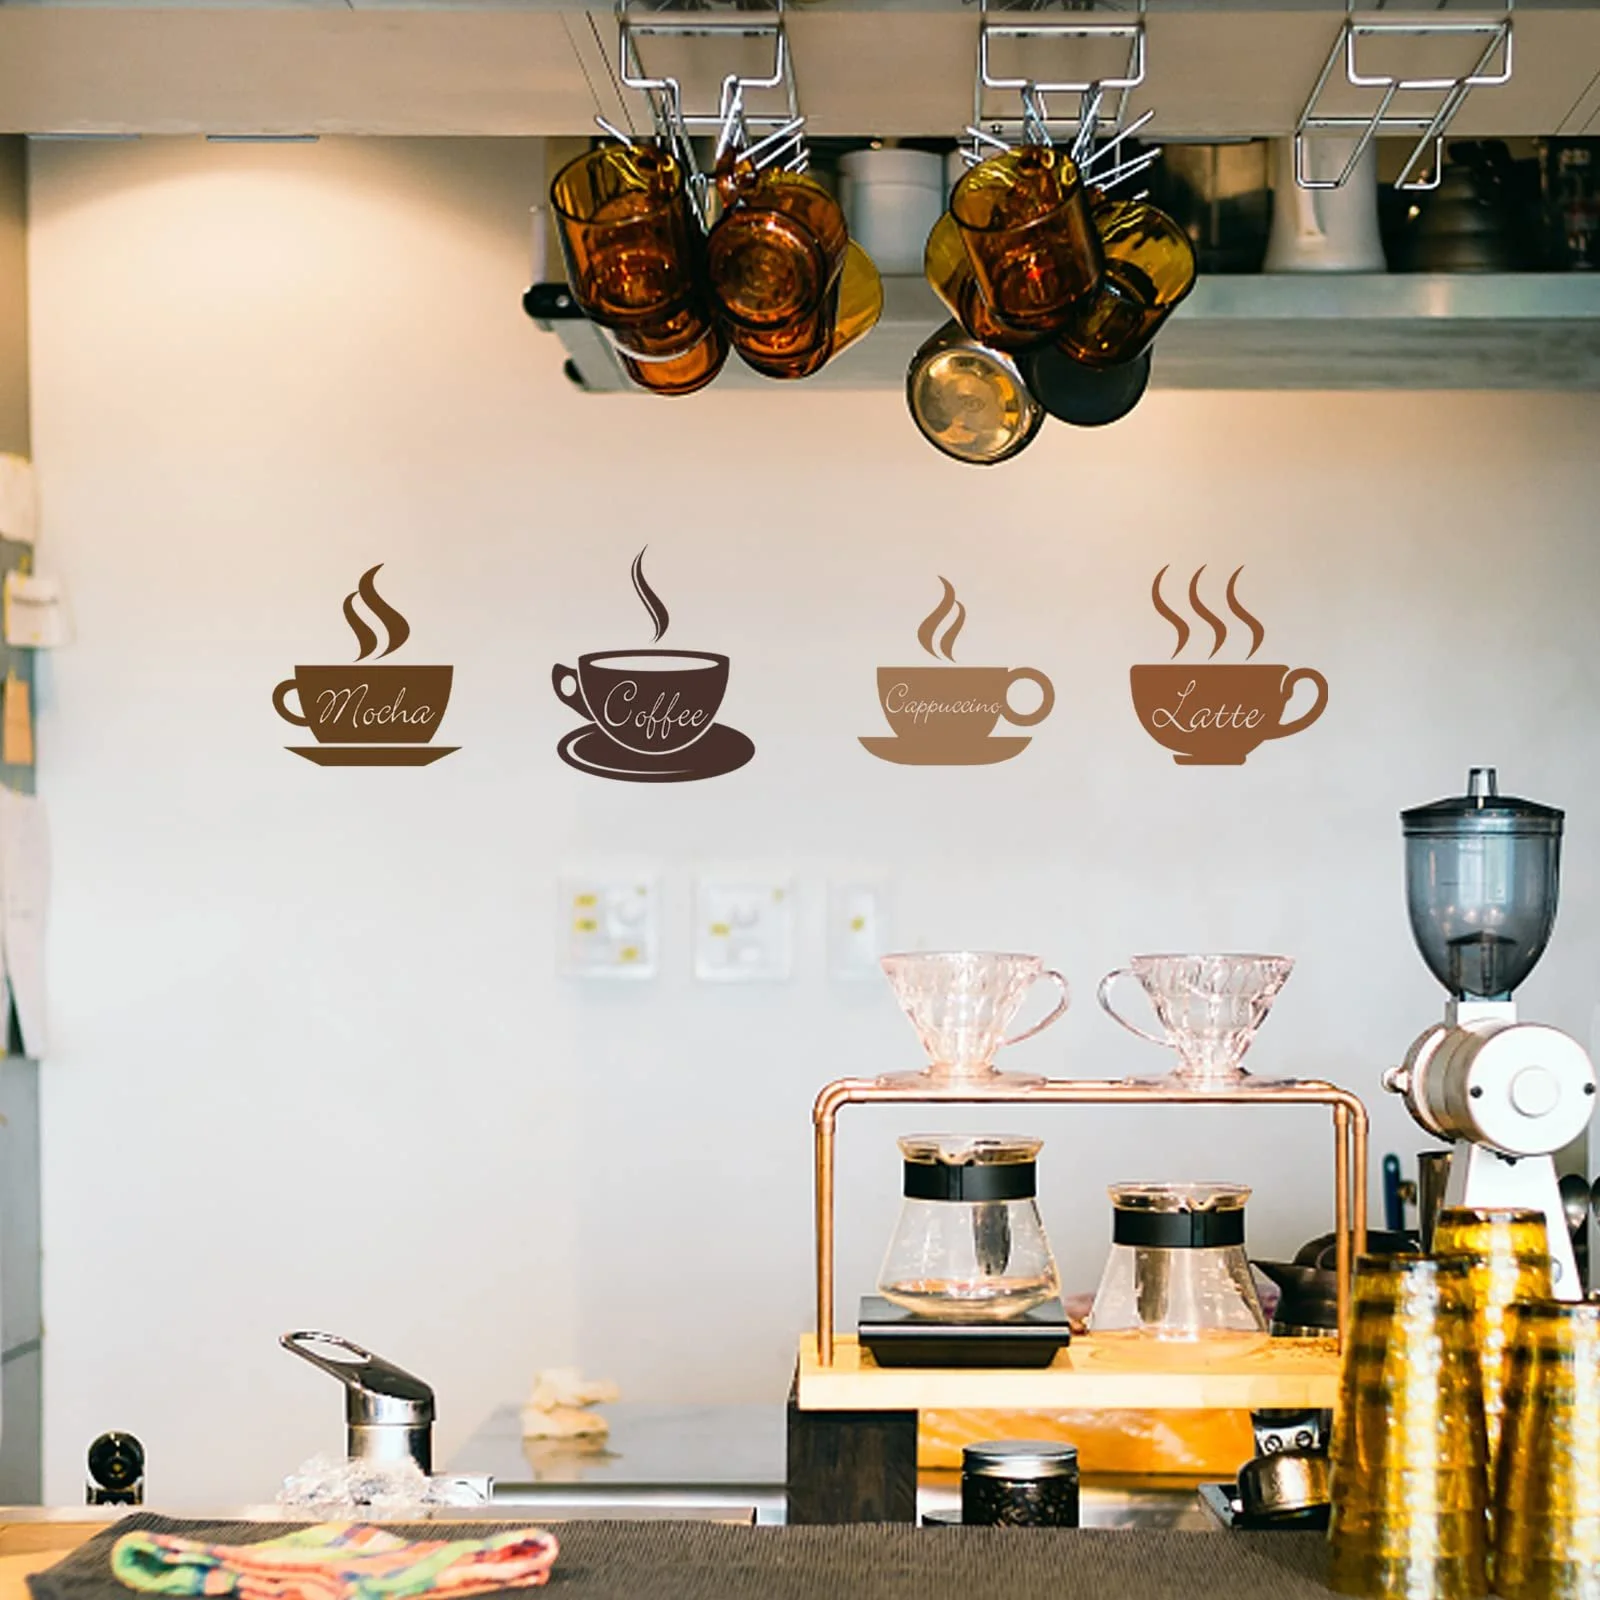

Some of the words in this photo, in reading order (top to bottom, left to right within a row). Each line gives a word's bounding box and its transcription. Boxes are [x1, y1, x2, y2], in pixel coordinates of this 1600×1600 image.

[316, 683, 436, 729] Mocha
[604, 680, 709, 739] Coffee
[886, 683, 1002, 724] Cappuccino
[1152, 679, 1266, 733] Latte
